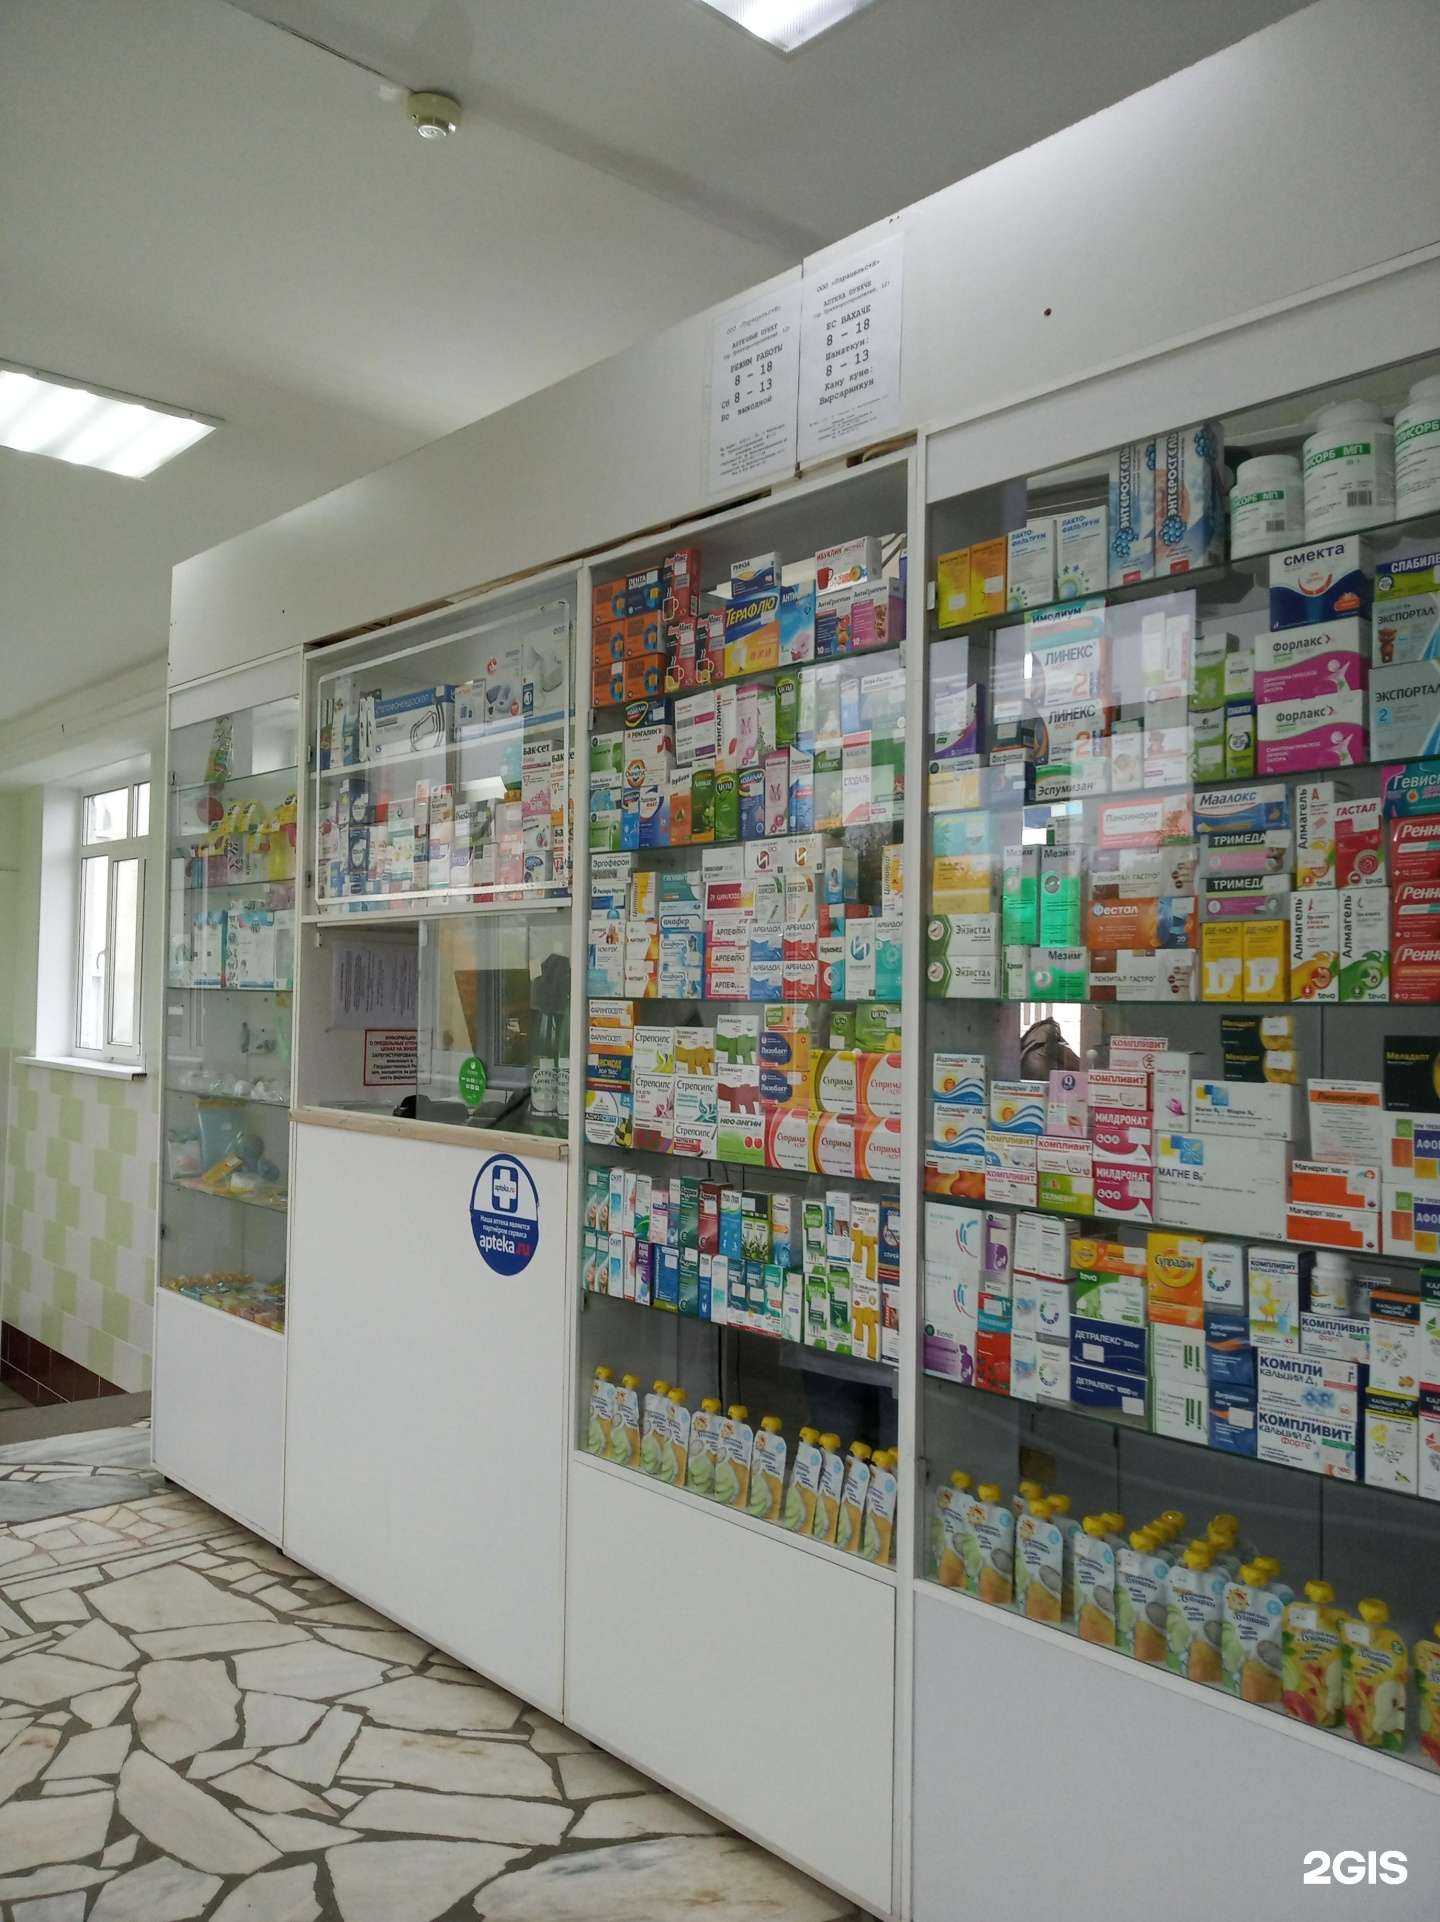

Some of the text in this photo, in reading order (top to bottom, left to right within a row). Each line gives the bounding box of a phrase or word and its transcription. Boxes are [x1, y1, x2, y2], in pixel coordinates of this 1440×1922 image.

[826, 318, 870, 346] 8 18
[756, 344, 783, 361] РАБОТЫ
[826, 349, 869, 377] 8 13
[734, 361, 773, 386] 8 18
[734, 392, 740, 404] 8
[759, 378, 772, 393] 13
[1377, 606, 1436, 625] ЭКСПОРТАЛ
[1273, 634, 1322, 654] Форлакс
[1045, 644, 1094, 666] ЛИНЕКС
[1048, 704, 1096, 724] ЛИНЕКС
[1276, 706, 1327, 723] Форлакс
[1378, 708, 1389, 722] 2
[1038, 783, 1094, 797] Эспумизан
[1200, 791, 1257, 807] Маалокс
[1336, 803, 1377, 817] ГАСТАЛ
[1298, 788, 1320, 850] Алмагель А
[1213, 832, 1266, 846] ТРИМЕДА
[1293, 898, 1304, 960] Алмагель
[1342, 895, 1353, 959] Алмагель
[635, 1032, 670, 1044] Стрепсилс
[1111, 1039, 1166, 1050] КОМПЛИВИТ
[635, 1078, 671, 1089] Стрепсилс
[677, 1080, 713, 1092] Стрепсилс
[1090, 1073, 1146, 1085] КОМПЛИВИТ
[1095, 1112, 1149, 1128] МИЛДРОНАТ
[676, 1126, 710, 1139] Стрепсилс
[1038, 1139, 1091, 1151] КОМПЛИВИТ
[986, 1170, 1035, 1182] КОМПЛИВИТ
[1096, 1167, 1149, 1182] МИЛДРОНАТ
[1158, 1168, 1191, 1179] МАГНЕ
[1302, 1318, 1370, 1334] КОМПЛИВИТ
[1075, 1330, 1120, 1344] ДЕТРАЛЕКС
[1259, 1412, 1352, 1441] КОМПЛИВИТ
